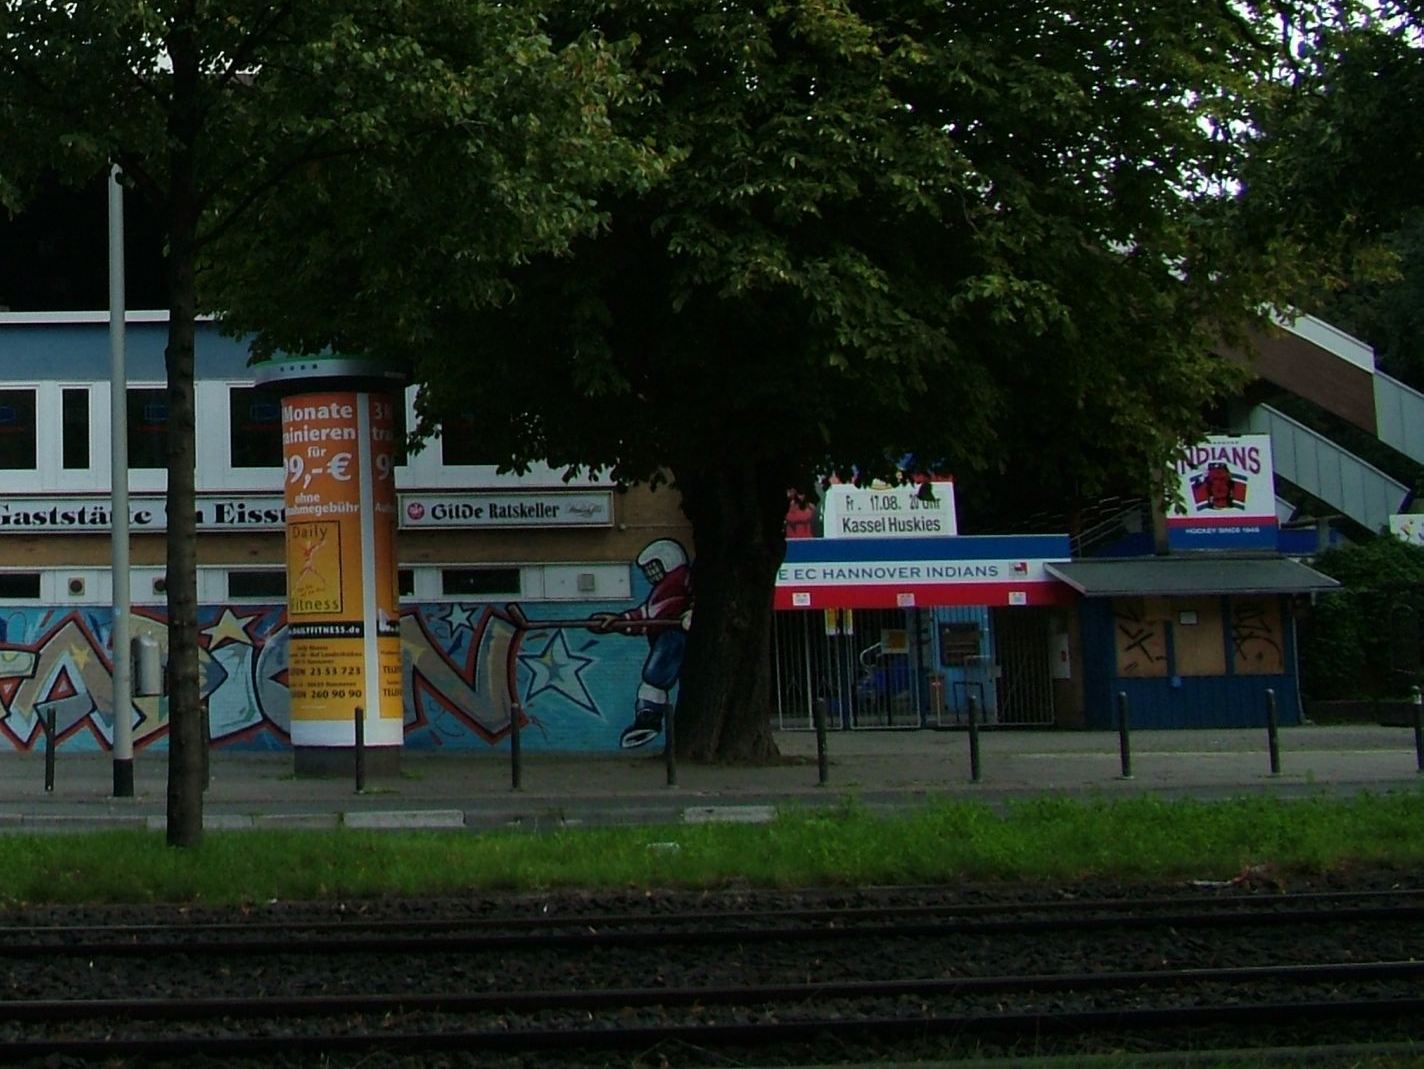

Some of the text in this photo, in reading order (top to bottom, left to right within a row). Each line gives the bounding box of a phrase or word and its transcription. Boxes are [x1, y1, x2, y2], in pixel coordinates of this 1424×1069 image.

[307, 446, 327, 458] für
[294, 492, 320, 504] ohne
[431, 502, 484, 521] Gilde
[488, 502, 560, 519] Ratskeller
[842, 516, 941, 533] Kassel Huskies
[292, 525, 328, 541] Daily
[794, 568, 817, 580] EC
[823, 566, 921, 581] HANNOVER
[927, 565, 999, 578] INDIANS
[342, 666, 361, 675] 723
[332, 689, 345, 699] 90
[348, 689, 362, 699] 90
